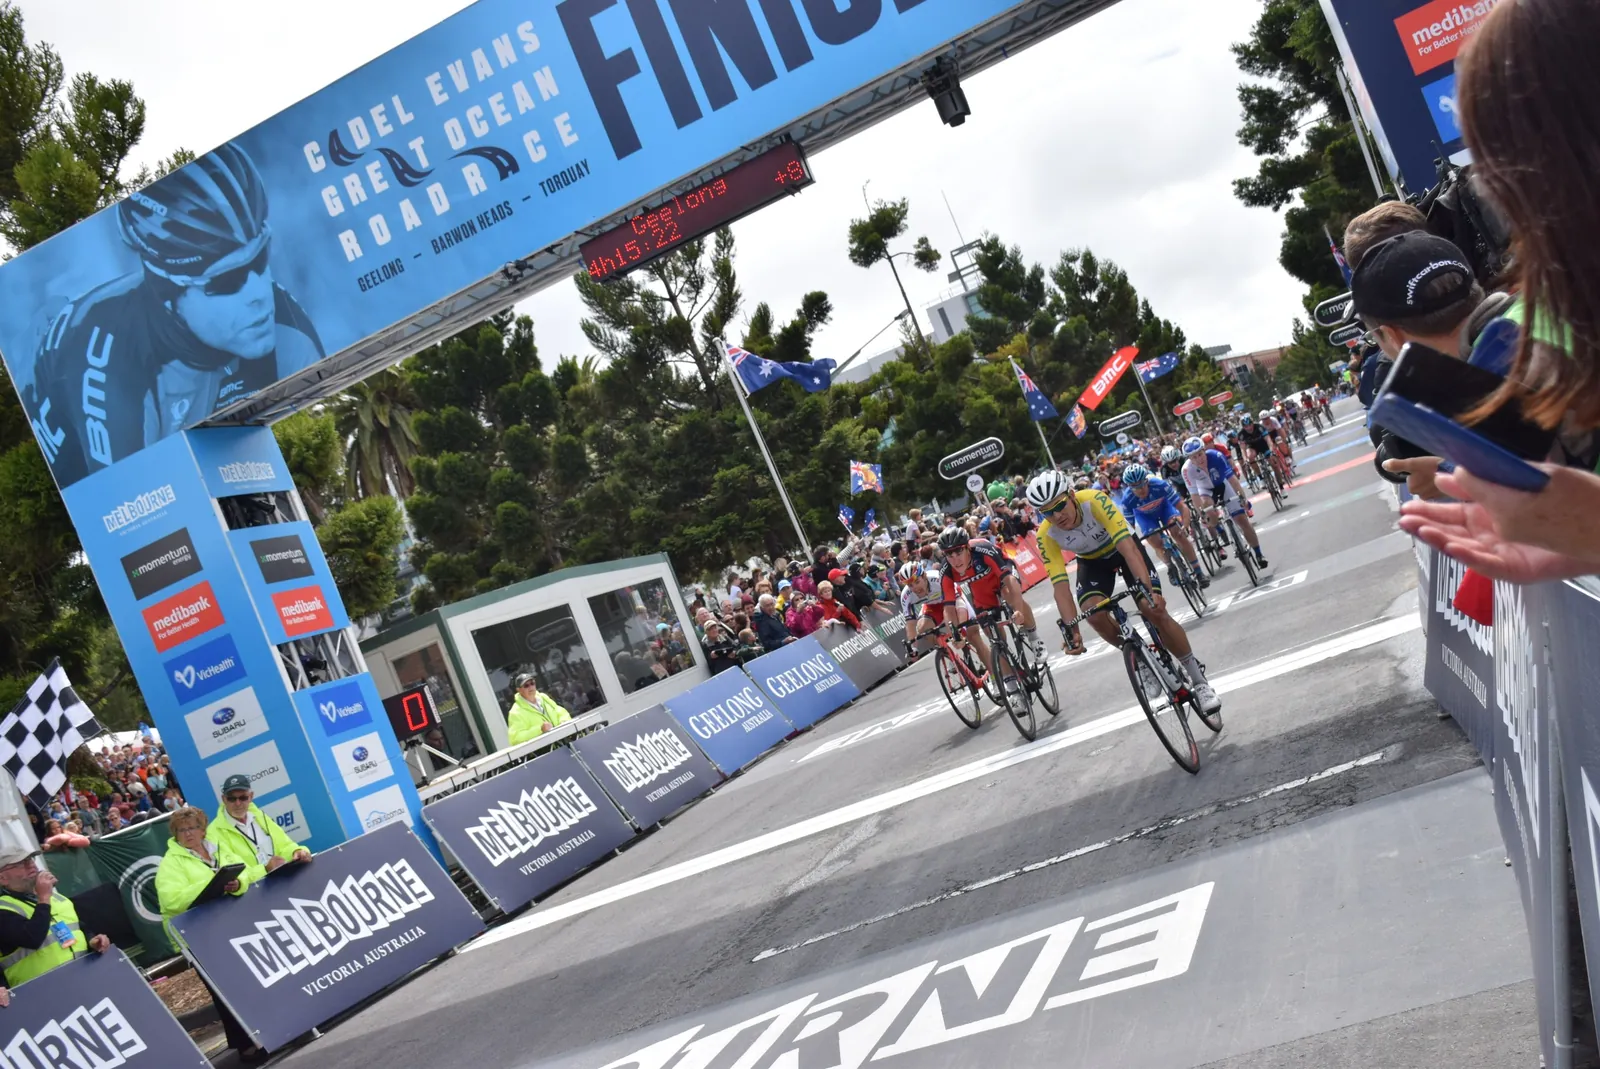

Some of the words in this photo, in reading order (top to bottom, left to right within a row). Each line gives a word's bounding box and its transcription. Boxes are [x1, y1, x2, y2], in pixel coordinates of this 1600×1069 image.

[1412, 0, 1498, 46] mediban
[425, 20, 540, 106] EVANS
[1418, 45, 1432, 56] For
[1433, 32, 1459, 50] Better
[321, 136, 434, 217] GREAT
[443, 65, 559, 151] OCEAN
[631, 178, 728, 236] Geelong
[774, 160, 803, 185] +8
[338, 182, 450, 262] ROAD
[357, 257, 405, 293] GEELONG
[431, 219, 478, 255] BARWON
[478, 201, 514, 237] HEADS
[539, 158, 592, 198] TORQUAY
[588, 222, 682, 278] 4h15:22
[1405, 260, 1470, 305] swiftcarbon.com
[1091, 354, 1127, 397] BMC
[82, 325, 114, 466] BMC
[218, 461, 276, 484] MELBOURNE
[951, 443, 998, 468] momentum
[103, 483, 177, 534] MELBOURNE
[1094, 491, 1117, 521] IAM
[138, 545, 189, 575] momentum
[172, 553, 192, 566] energy
[266, 549, 303, 562] momentum
[153, 596, 212, 632] medibank
[281, 597, 324, 618] medibank
[881, 610, 907, 637] moment
[158, 631, 168, 640] For
[831, 628, 879, 663] momentum
[197, 657, 235, 682] VicHealth
[766, 652, 834, 699] GEELONG
[813, 673, 843, 694] AUSTRALIA
[1441, 643, 1464, 681] VICTORIA
[1463, 663, 1487, 709] AUSTRALIA
[212, 719, 247, 739] SUBARU
[337, 702, 364, 718] VicHealth
[402, 692, 429, 731] 0
[688, 686, 764, 739] GEELONG
[741, 709, 774, 733] AUSTRALIA
[354, 760, 378, 774] SUBARU
[602, 727, 693, 794] MELBOURNE
[668, 770, 696, 791] AUSTRALIA
[464, 775, 598, 868] MELBOURNE
[519, 849, 557, 876] VICTORIA
[556, 828, 597, 859] AUSTRALIA
[229, 857, 436, 989] MELBOURNE
[301, 959, 365, 997] VICTORIA
[364, 925, 427, 976] AUSTRALIA
